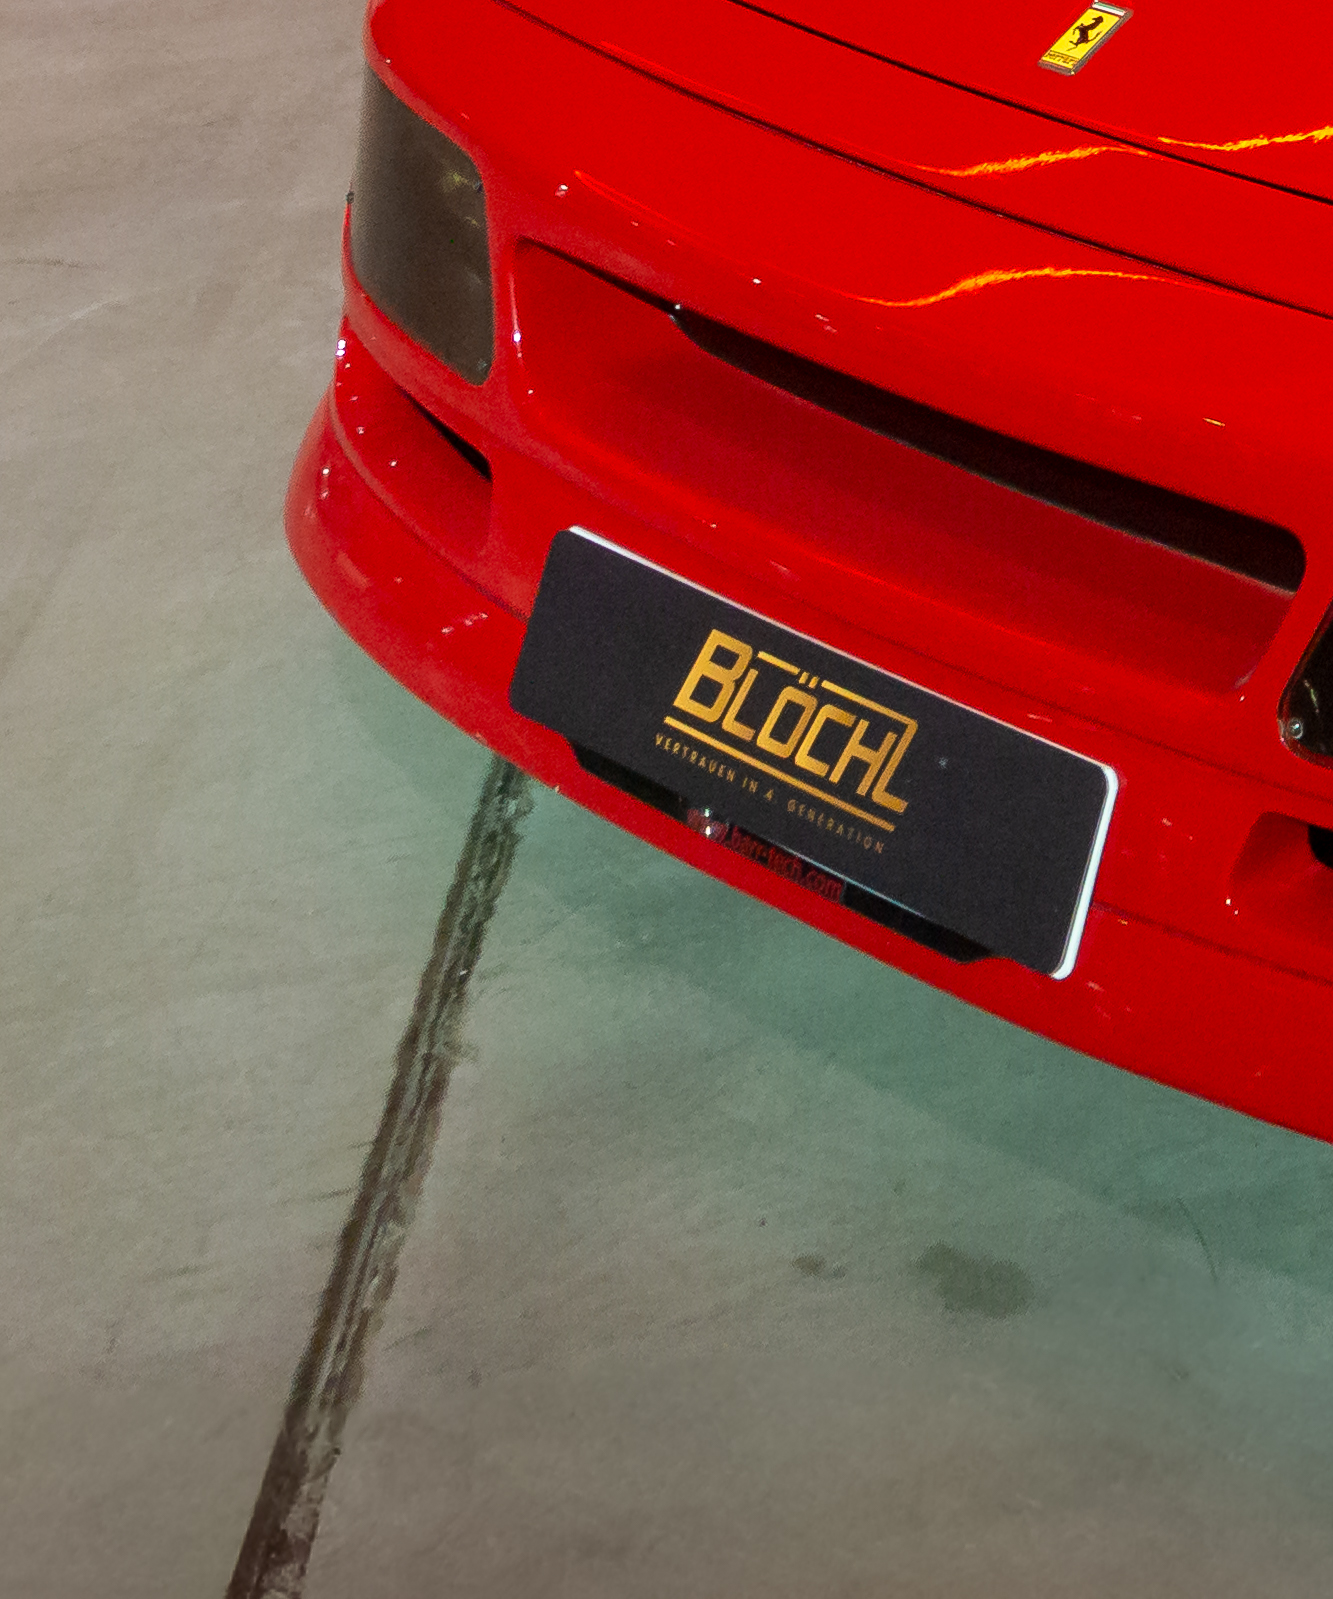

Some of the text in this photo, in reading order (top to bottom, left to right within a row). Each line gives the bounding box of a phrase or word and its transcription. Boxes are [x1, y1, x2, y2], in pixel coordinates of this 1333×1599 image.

[655, 732, 737, 782] VERTRAUEN
[742, 776, 760, 794] IN
[787, 798, 885, 854] GENERATION
[672, 628, 919, 814] BLÖCHL
